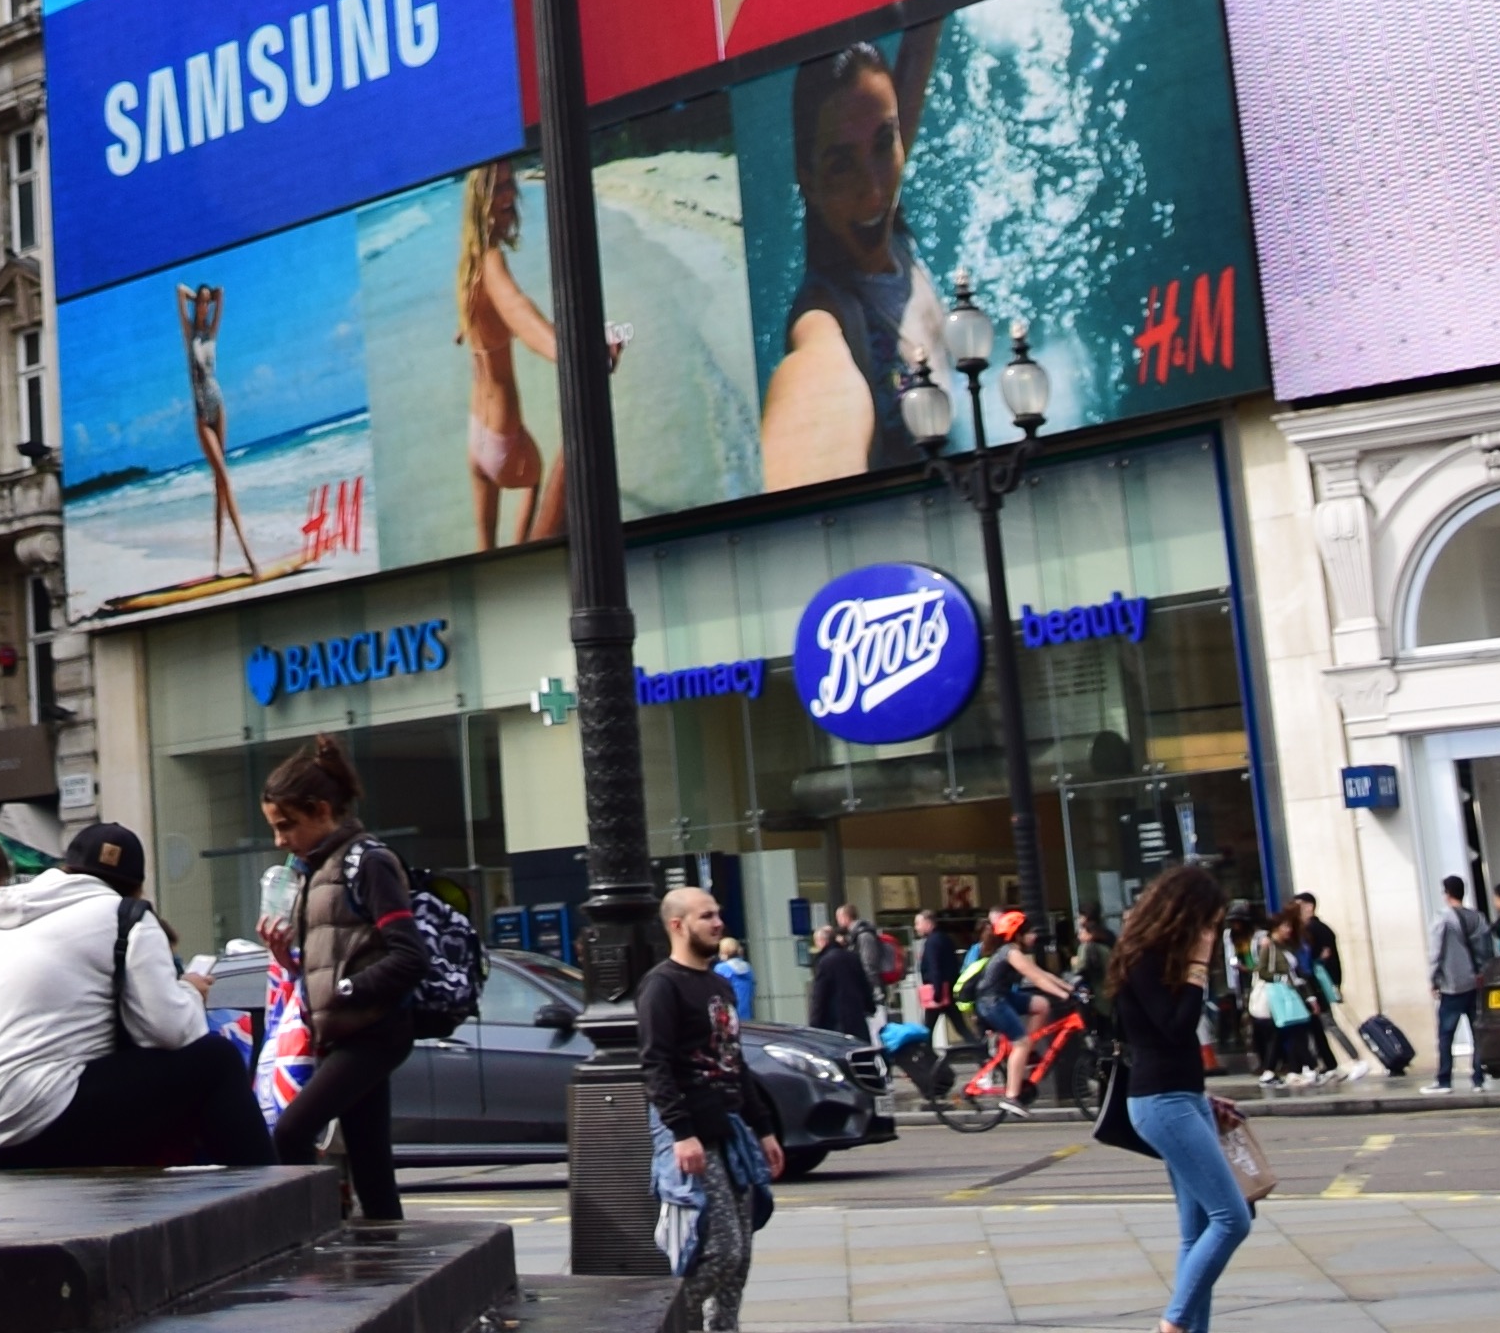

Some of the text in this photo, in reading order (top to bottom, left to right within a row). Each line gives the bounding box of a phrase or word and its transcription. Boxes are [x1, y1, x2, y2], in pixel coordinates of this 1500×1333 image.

[1136, 265, 1236, 386] H&M
[300, 476, 364, 562] H&M
[282, 620, 447, 695] BARCLAYS
[809, 588, 950, 719] Boots
[1022, 590, 1149, 648] beauty
[634, 655, 766, 707] harmacy
